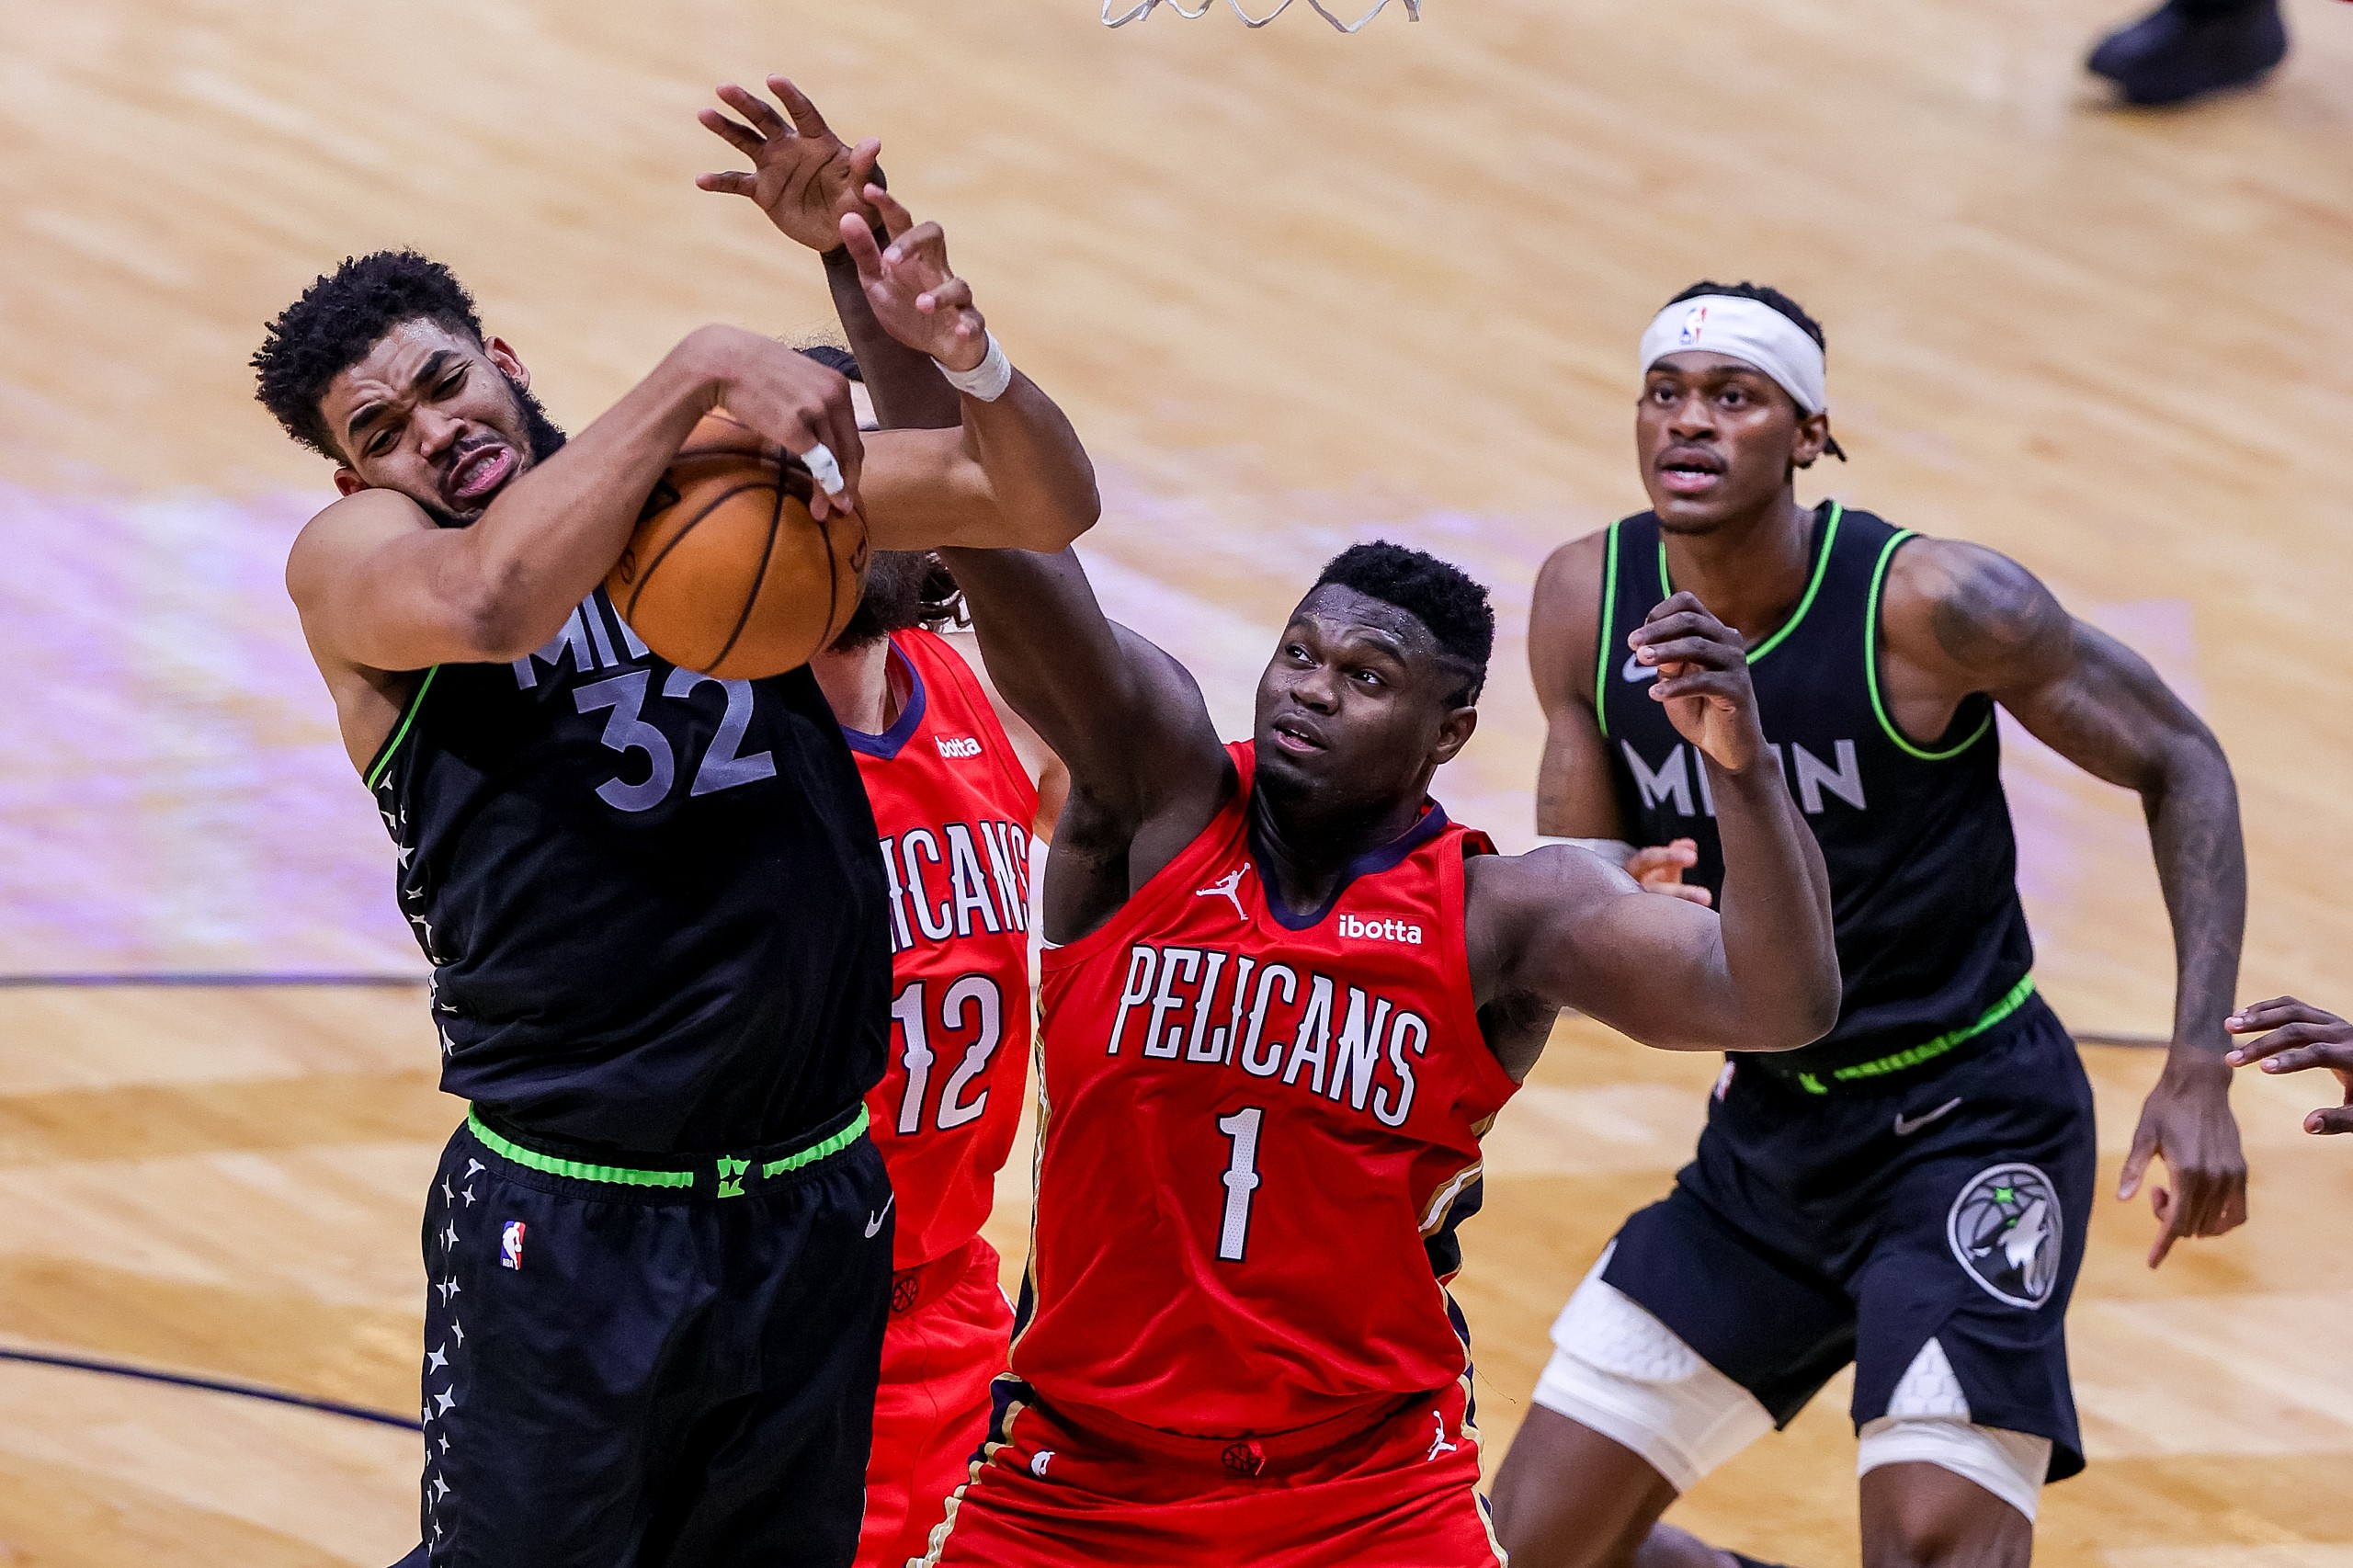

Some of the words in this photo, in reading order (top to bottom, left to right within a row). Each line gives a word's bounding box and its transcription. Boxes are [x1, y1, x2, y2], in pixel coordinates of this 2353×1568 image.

[512, 593, 651, 689] MI
[572, 668, 777, 812] 32
[1620, 738, 1868, 817] MIN
[880, 820, 1030, 953] ICANS
[1338, 914, 1422, 945] ibotta
[892, 975, 1002, 1134] 12
[1107, 945, 1429, 1128] PELICANS
[1218, 1107, 1263, 1261] 1
